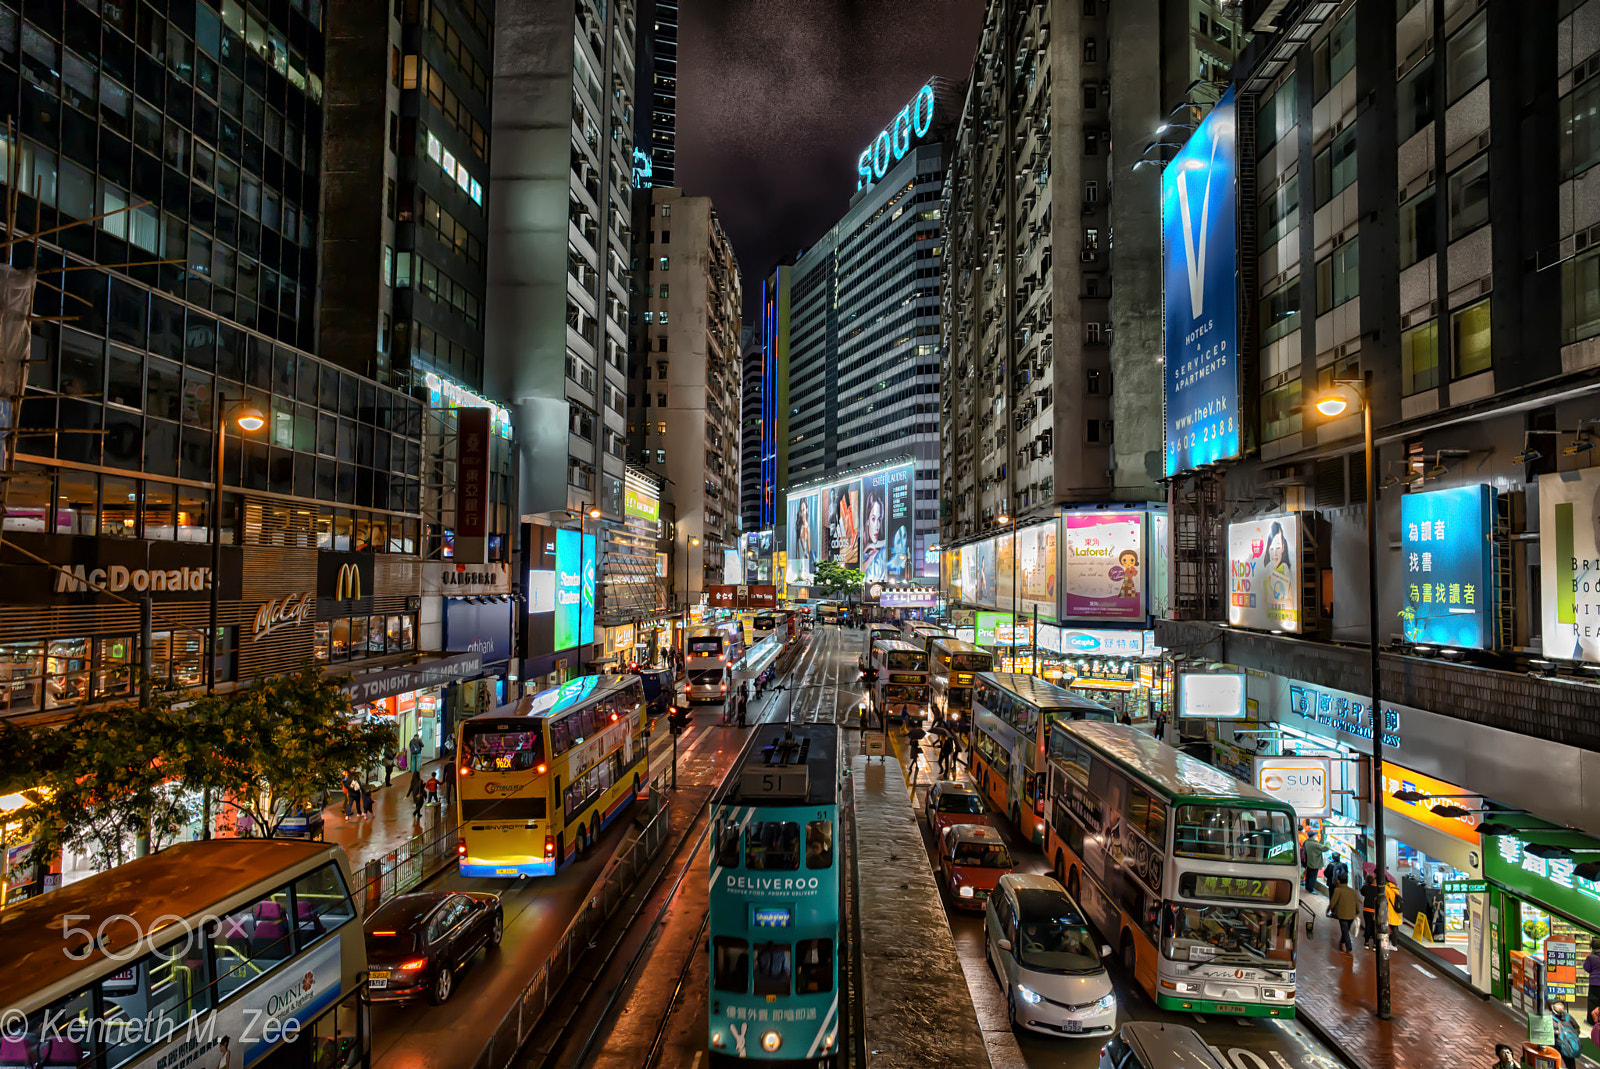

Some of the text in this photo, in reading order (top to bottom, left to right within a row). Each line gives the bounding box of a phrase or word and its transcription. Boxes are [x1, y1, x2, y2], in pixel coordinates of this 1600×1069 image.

[858, 85, 934, 191] SOGO
[1185, 319, 1213, 346] HOTELS
[1175, 340, 1227, 379] SERVICED
[1175, 355, 1227, 393] APARTMENTS
[1175, 395, 1227, 430] www.theV.hk
[1170, 416, 1233, 455] 3602 2388
[1408, 519, 1446, 542] 為讀者
[831, 538, 850, 549] adidas
[1075, 547, 1108, 557] Laforet
[1408, 552, 1432, 572] 找書
[1231, 578, 1251, 593] LAND
[1409, 582, 1476, 605] 為書找讀者
[467, 637, 495, 654] citibank
[362, 673, 411, 698] TONIGHT
[461, 658, 480, 673] TIME
[1380, 733, 1400, 749] RESS
[496, 758, 512, 769] 962X
[762, 775, 782, 792] 51
[1287, 775, 1322, 786] SUN
[816, 810, 827, 819] 51
[1498, 834, 1576, 889] 華潤堂
[727, 875, 819, 890] DELIVEROO
[1251, 880, 1271, 897] 2A
[266, 982, 302, 1017] OMNI
